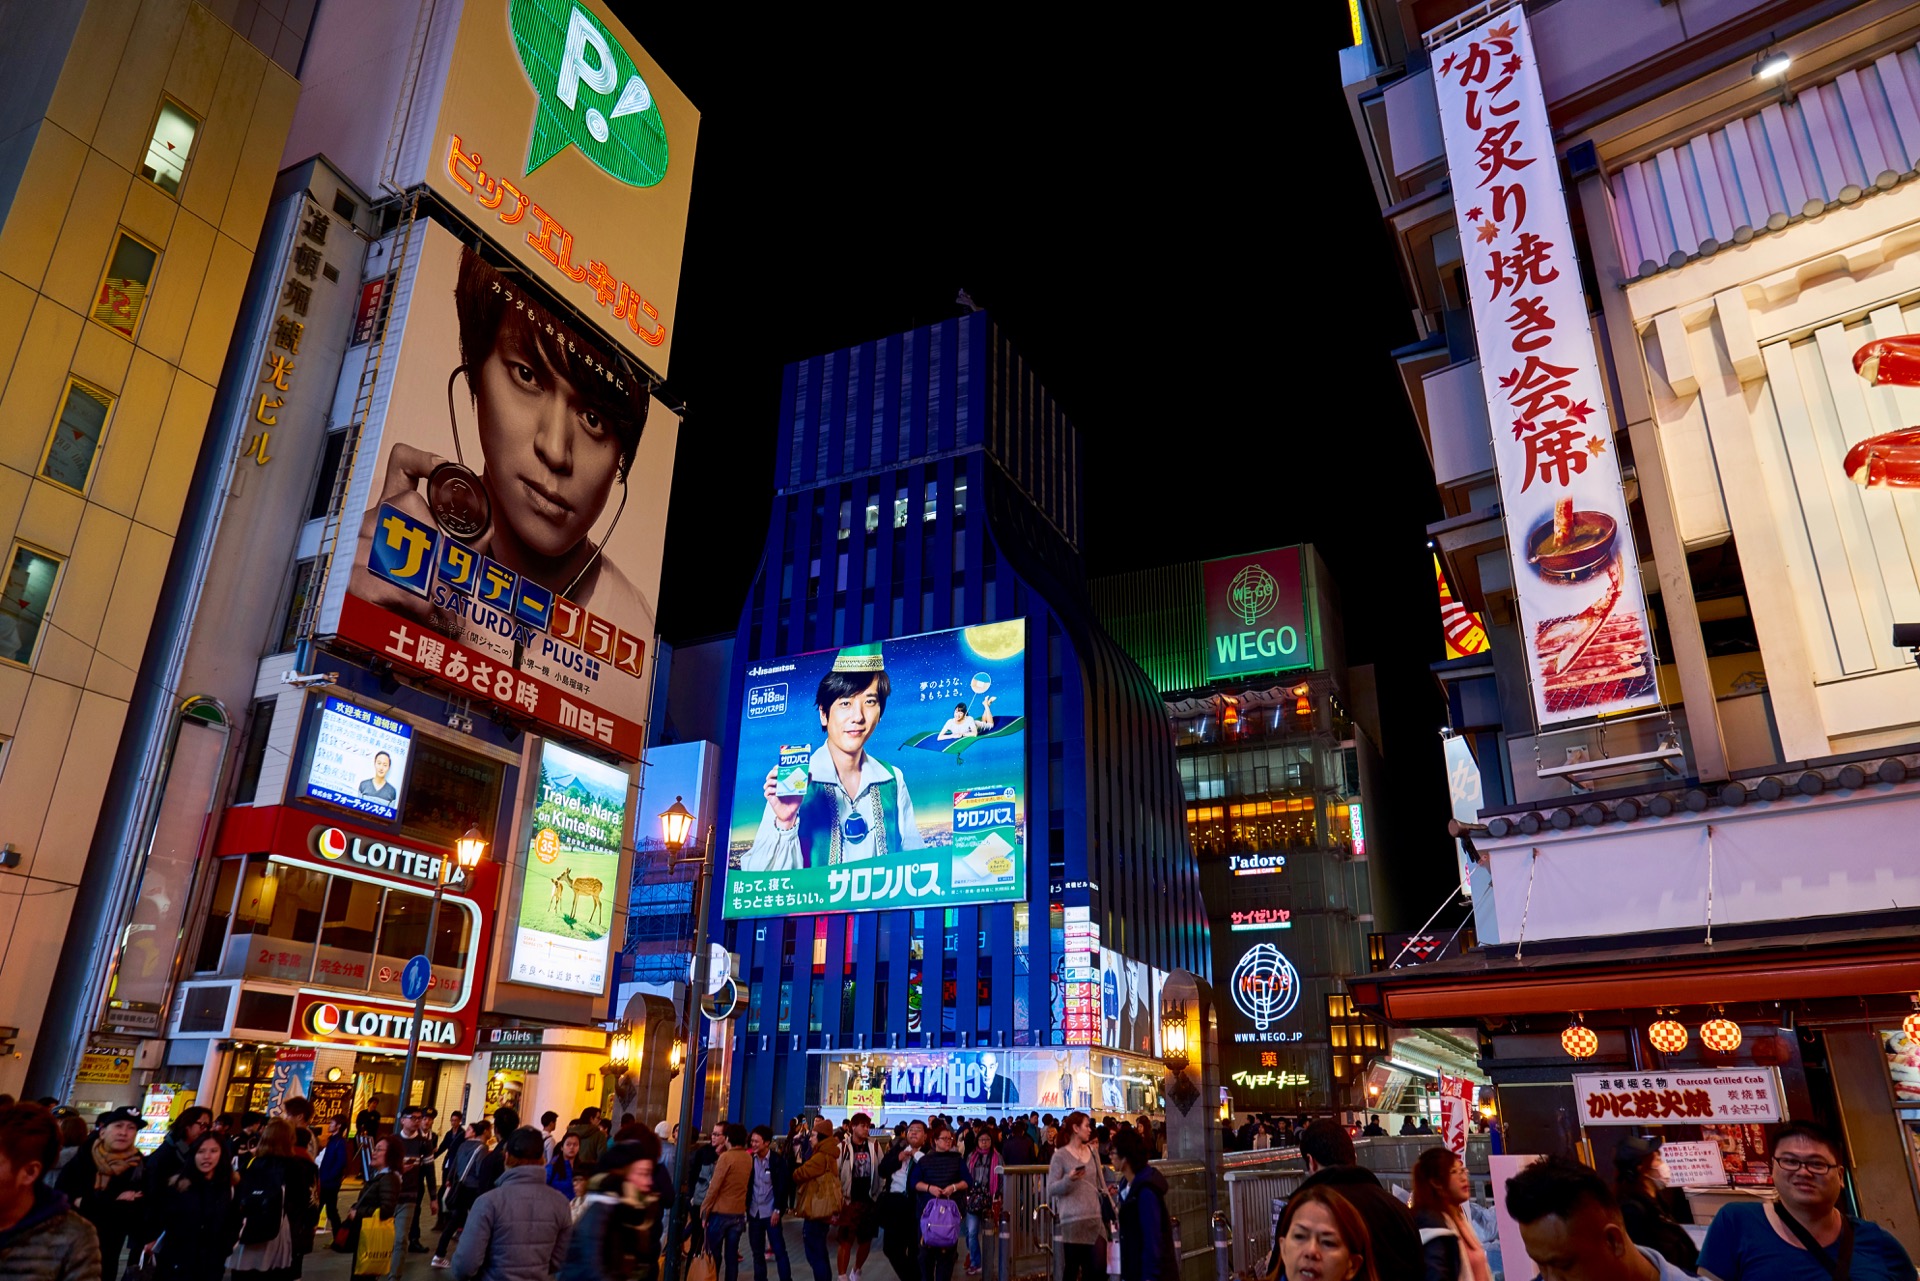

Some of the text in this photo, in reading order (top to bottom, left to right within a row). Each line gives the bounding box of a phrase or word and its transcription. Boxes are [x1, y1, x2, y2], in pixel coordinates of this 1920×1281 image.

[1459, 36, 1590, 495] かに炙り焼き会席
[243, 204, 330, 465] 道頓堀観光ビル
[491, 280, 630, 396] カラダも、お金も、お大事に。
[433, 584, 583, 674] SATURDAY PLUS
[1215, 625, 1298, 664] WEGO
[385, 624, 540, 714] 土曜あさ8時
[542, 783, 620, 825] Travel to Nara
[956, 807, 1014, 828] サロンパス
[538, 809, 607, 842] on Kintetsu.
[540, 839, 554, 854] 35
[1229, 853, 1286, 871] J'adore
[827, 861, 942, 903] サロンパス
[732, 891, 825, 910] もっときもちいい。
[1231, 909, 1290, 925] サイゼリヤ
[503, 1030, 531, 1042] Toilets
[1234, 1032, 1303, 1042] WWW.WEGO.JP
[1600, 1078, 1668, 1090] 道頓堀名物
[1676, 1076, 1764, 1086] Charcoal Grilled Crab
[1586, 1089, 1713, 1119] かに炭火焼
